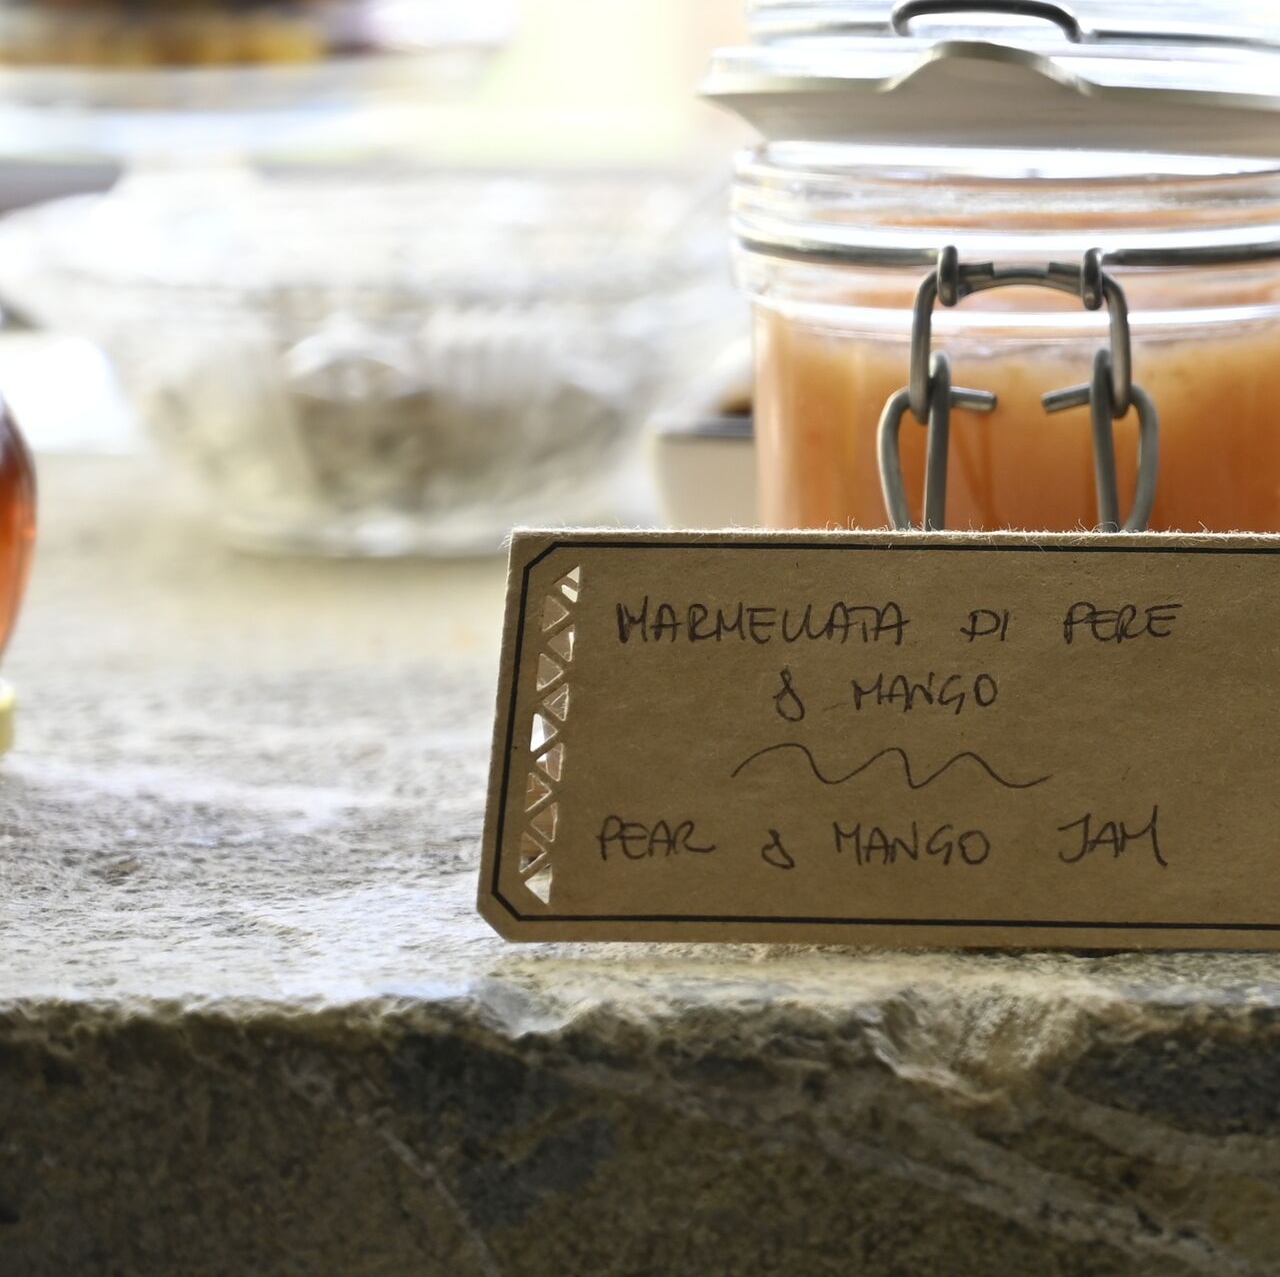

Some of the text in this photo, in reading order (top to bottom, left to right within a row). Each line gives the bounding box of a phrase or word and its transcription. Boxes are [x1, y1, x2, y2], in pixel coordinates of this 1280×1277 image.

[960, 609, 1010, 643] DI
[1062, 601, 1182, 645] PERE
[851, 671, 998, 715] MANGO
[597, 815, 716, 861] PEAR
[833, 822, 991, 866] MANGO
[1058, 805, 1168, 868] JAM
